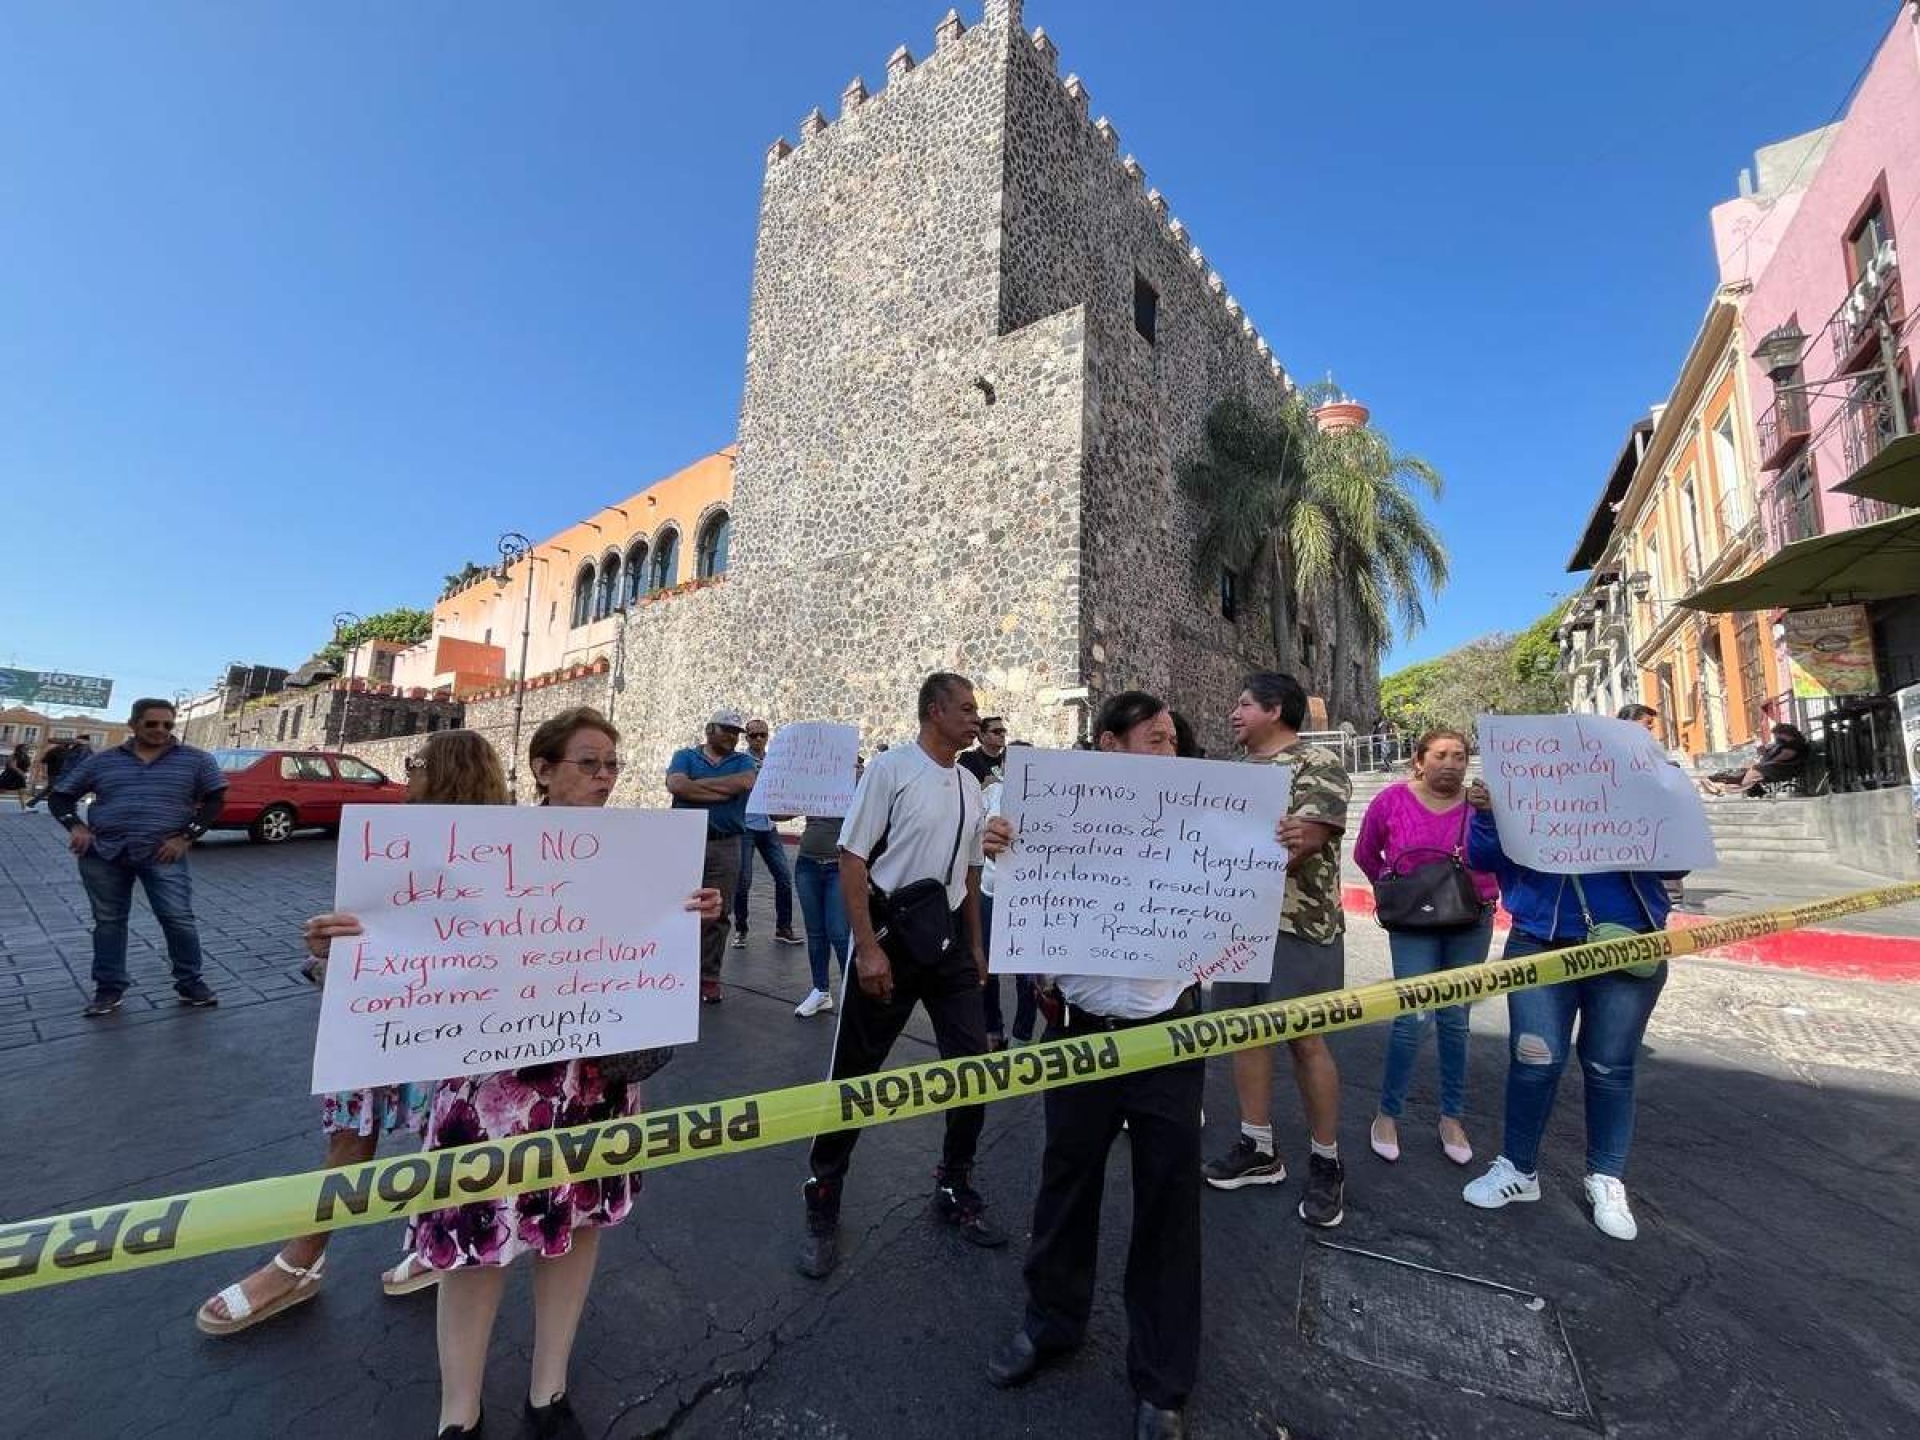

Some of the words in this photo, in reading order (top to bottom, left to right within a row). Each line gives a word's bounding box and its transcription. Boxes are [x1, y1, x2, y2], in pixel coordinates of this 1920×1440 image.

[38, 672, 108, 690] HOTEL
[1487, 725, 1560, 754] Fuera
[1575, 719, 1603, 753] la
[1022, 762, 1137, 817] Exigimos
[1142, 781, 1249, 822] justicia
[1018, 812, 1054, 835] Los
[1072, 821, 1134, 836] socios
[1140, 819, 1165, 839] de
[1179, 819, 1202, 843] la
[363, 820, 411, 862] La
[448, 820, 513, 891] Ley
[541, 830, 601, 862] NO
[1009, 837, 1124, 864] Cooperativa
[1138, 844, 1171, 862] del
[393, 870, 486, 906] debe
[505, 880, 574, 900] ser
[1014, 862, 1132, 887] solicitamos
[1148, 876, 1256, 899] resuelvan
[1008, 890, 1099, 914] conforme
[1113, 901, 1126, 913] a
[1139, 897, 1232, 923] derecho
[1044, 912, 1080, 928] LEY
[1203, 931, 1216, 940] a
[351, 941, 499, 988] Exigimos
[521, 935, 659, 968] resuelvan
[1006, 935, 1025, 956] de
[1041, 935, 1068, 956] los
[349, 982, 499, 1014] conforme
[519, 984, 537, 1000] a
[372, 1020, 463, 1053] Fuera
[479, 1001, 624, 1036] Corruptos
[1168, 994, 1363, 1057] PRECAUCIÓN
[462, 1032, 602, 1066] CONTADORA
[840, 1038, 1120, 1122] PRECAUCIÓN
[316, 1100, 761, 1222] PRECAUCIÓN
